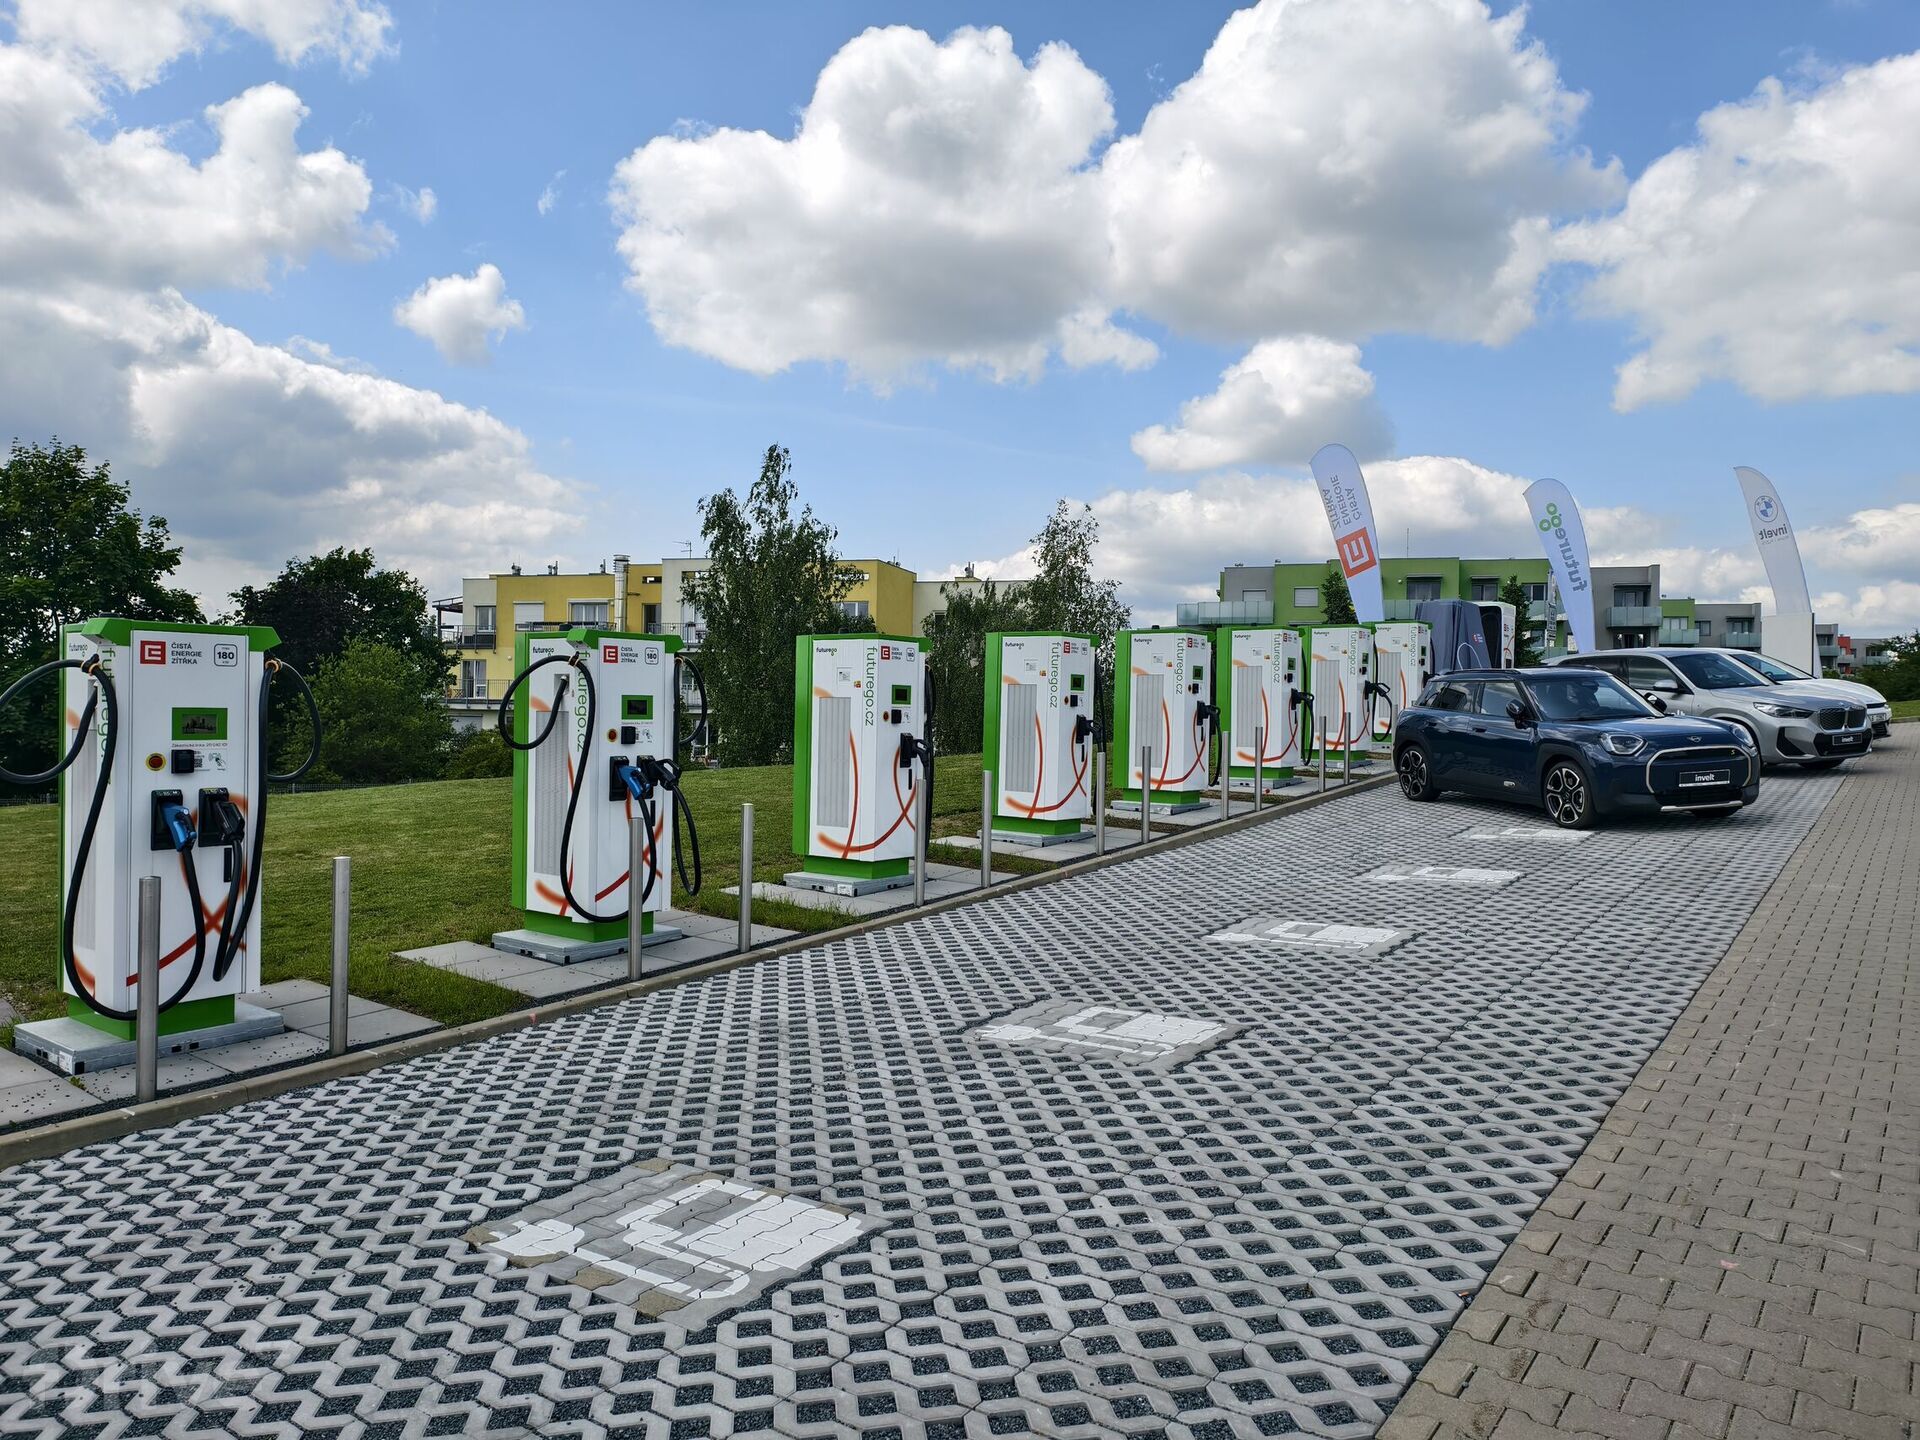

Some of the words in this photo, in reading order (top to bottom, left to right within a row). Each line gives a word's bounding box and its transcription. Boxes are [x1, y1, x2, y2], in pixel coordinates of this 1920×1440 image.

[217, 651, 235, 660] 180
[533, 647, 554, 657] futurego
[816, 646, 837, 656] futurego
[171, 657, 198, 665] ZÍTŘKA
[1272, 633, 1282, 683] futurego.cz
[1175, 638, 1186, 695] futurego.cz
[1049, 642, 1062, 708] futurego.cz
[863, 646, 878, 726] futurego.cz
[1694, 773, 1715, 782] invelt
